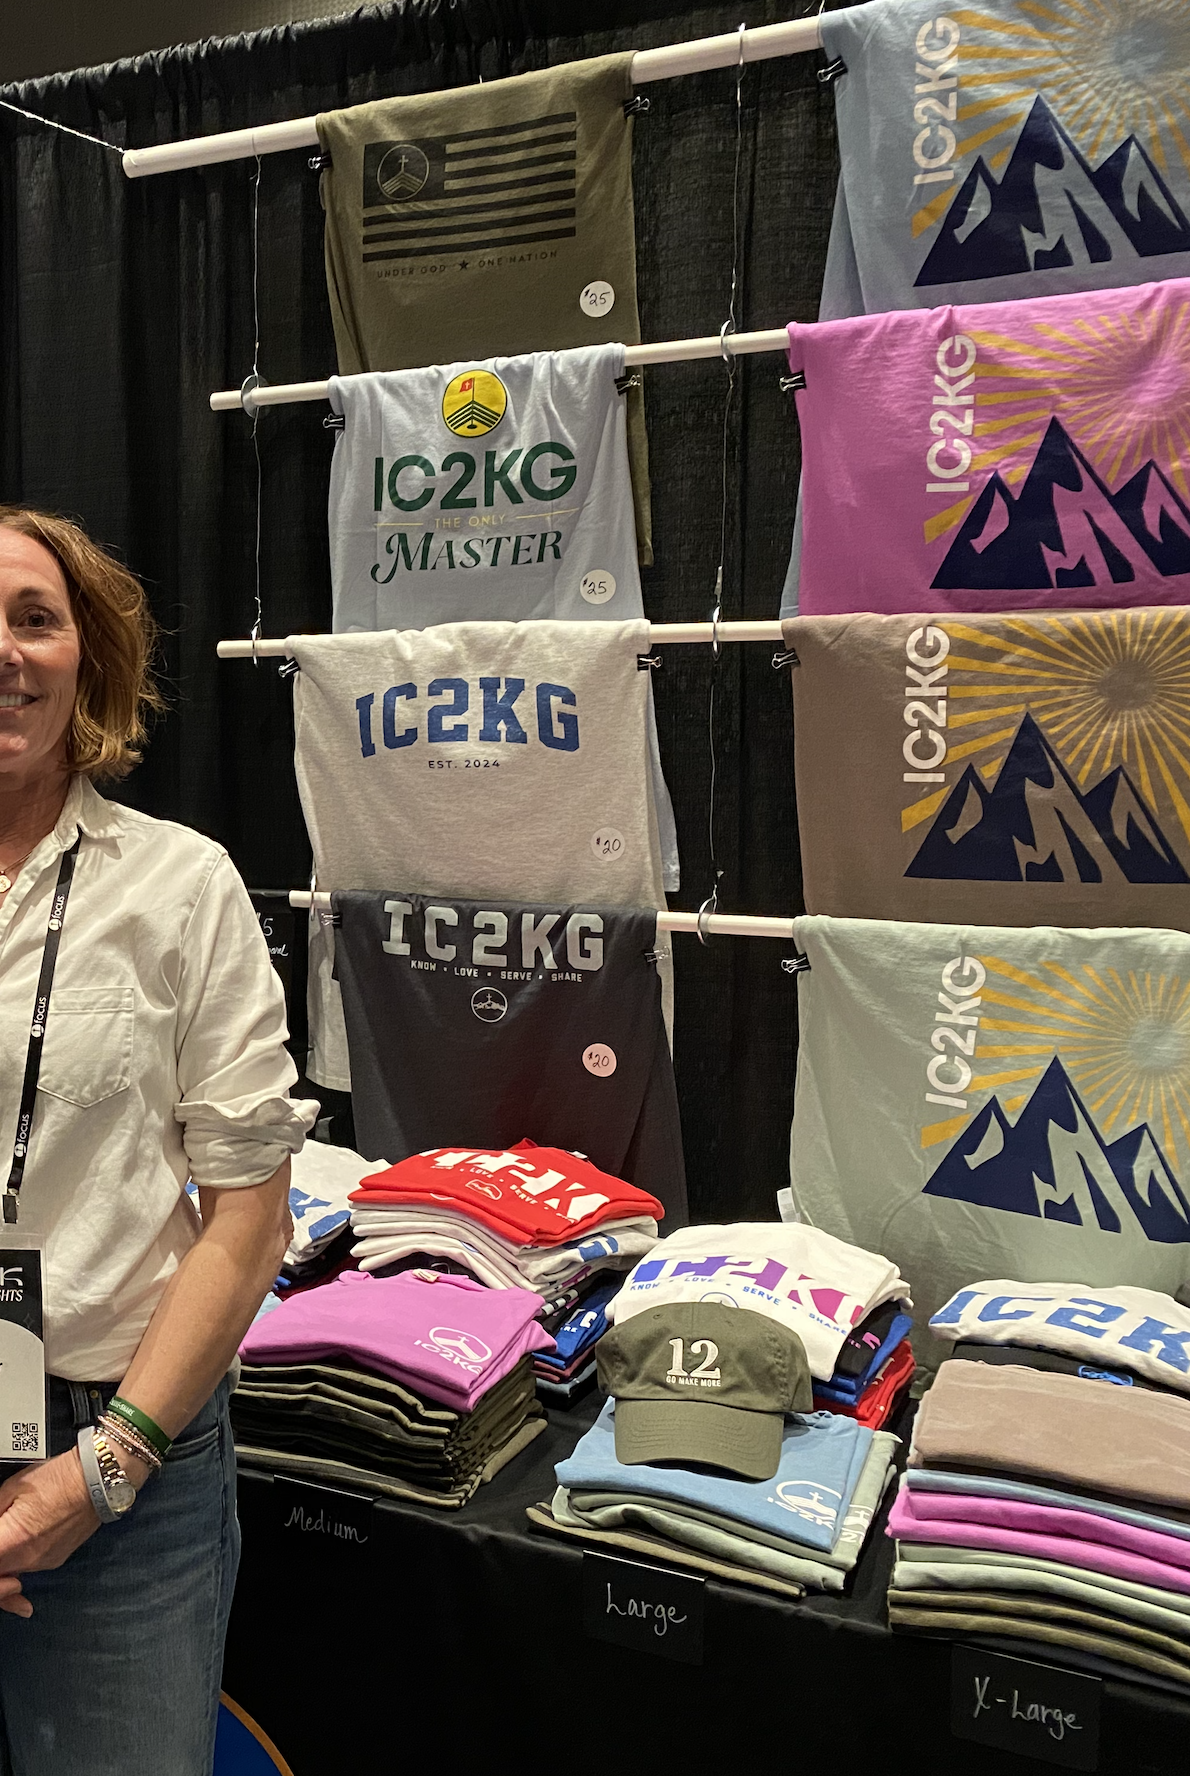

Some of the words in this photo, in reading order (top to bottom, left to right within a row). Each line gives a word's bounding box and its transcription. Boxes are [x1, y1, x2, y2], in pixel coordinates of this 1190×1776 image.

[913, 16, 961, 185] IC2KG
[377, 267, 415, 278] UNDER
[420, 263, 446, 274] GOD
[478, 257, 502, 268] ONE
[510, 250, 559, 263] NATION
[926, 335, 976, 492] IC2KG
[373, 441, 578, 512] IC2KG
[434, 517, 460, 529] THE
[468, 513, 506, 528] ONLY
[355, 676, 580, 758] IC2KG
[903, 626, 950, 783] IC2KG
[428, 760, 458, 769] EST.
[465, 759, 501, 769] 2024
[51, 894, 64, 919] focus
[382, 899, 605, 972] IC2KG
[411, 960, 437, 972] KNOW
[454, 967, 478, 978] LOVE
[500, 970, 532, 982] SERVE
[551, 972, 583, 983] SHARE
[34, 996, 46, 1023] focus
[925, 956, 987, 1110] IC2KG
[17, 1114, 29, 1142] focus
[469, 1167, 494, 1179] LOVE
[509, 1184, 538, 1205] SERVE
[743, 1286, 781, 1306] SERVE
[809, 1312, 848, 1337] SHARE
[666, 1337, 721, 1379] 12
[666, 1375, 677, 1384] GO
[678, 1377, 699, 1387] MAKE
[700, 1378, 721, 1387] MORE
[284, 1505, 368, 1543] Medium
[606, 1582, 687, 1636] Large
[973, 1676, 1084, 1740] X-Large
